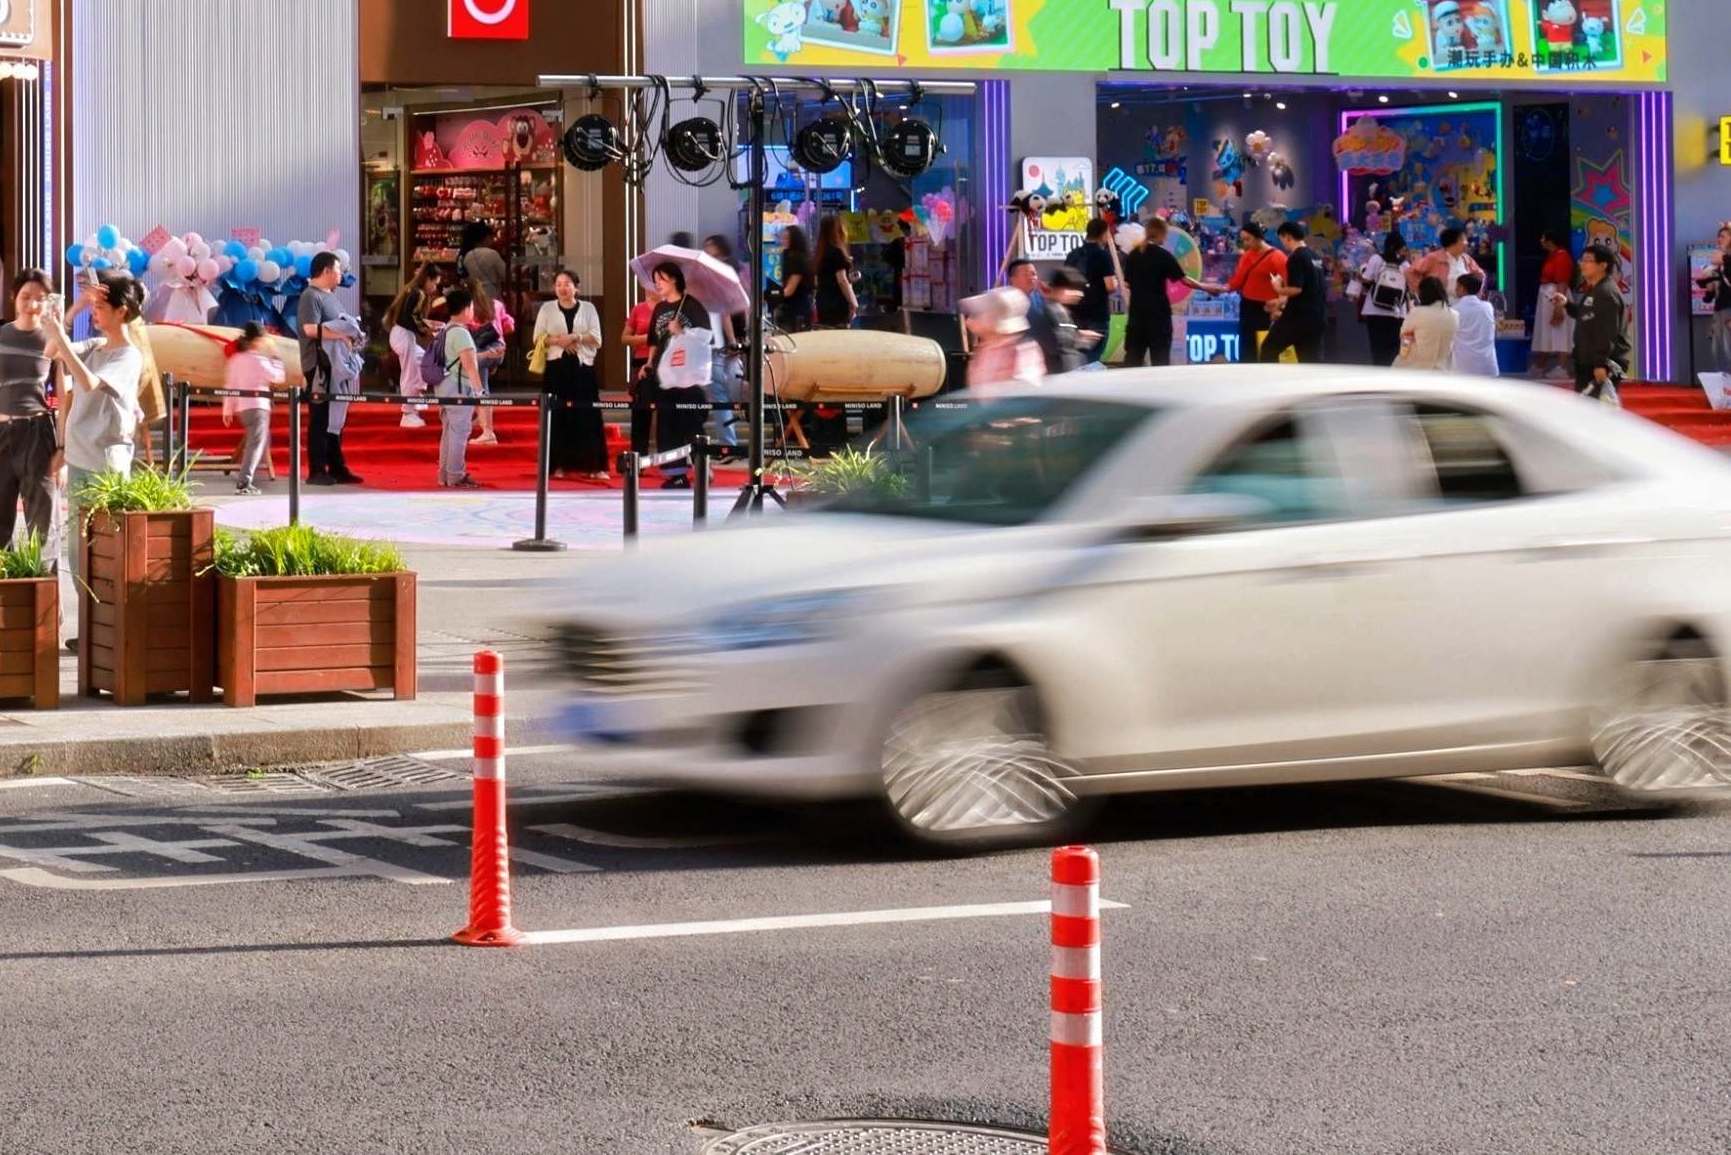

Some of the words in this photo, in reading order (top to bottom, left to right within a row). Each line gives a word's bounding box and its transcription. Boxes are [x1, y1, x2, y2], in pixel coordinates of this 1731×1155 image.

[1229, 0, 1338, 74] TOY
[1029, 234, 1057, 251] TOP
[1186, 334, 1217, 362] OP
